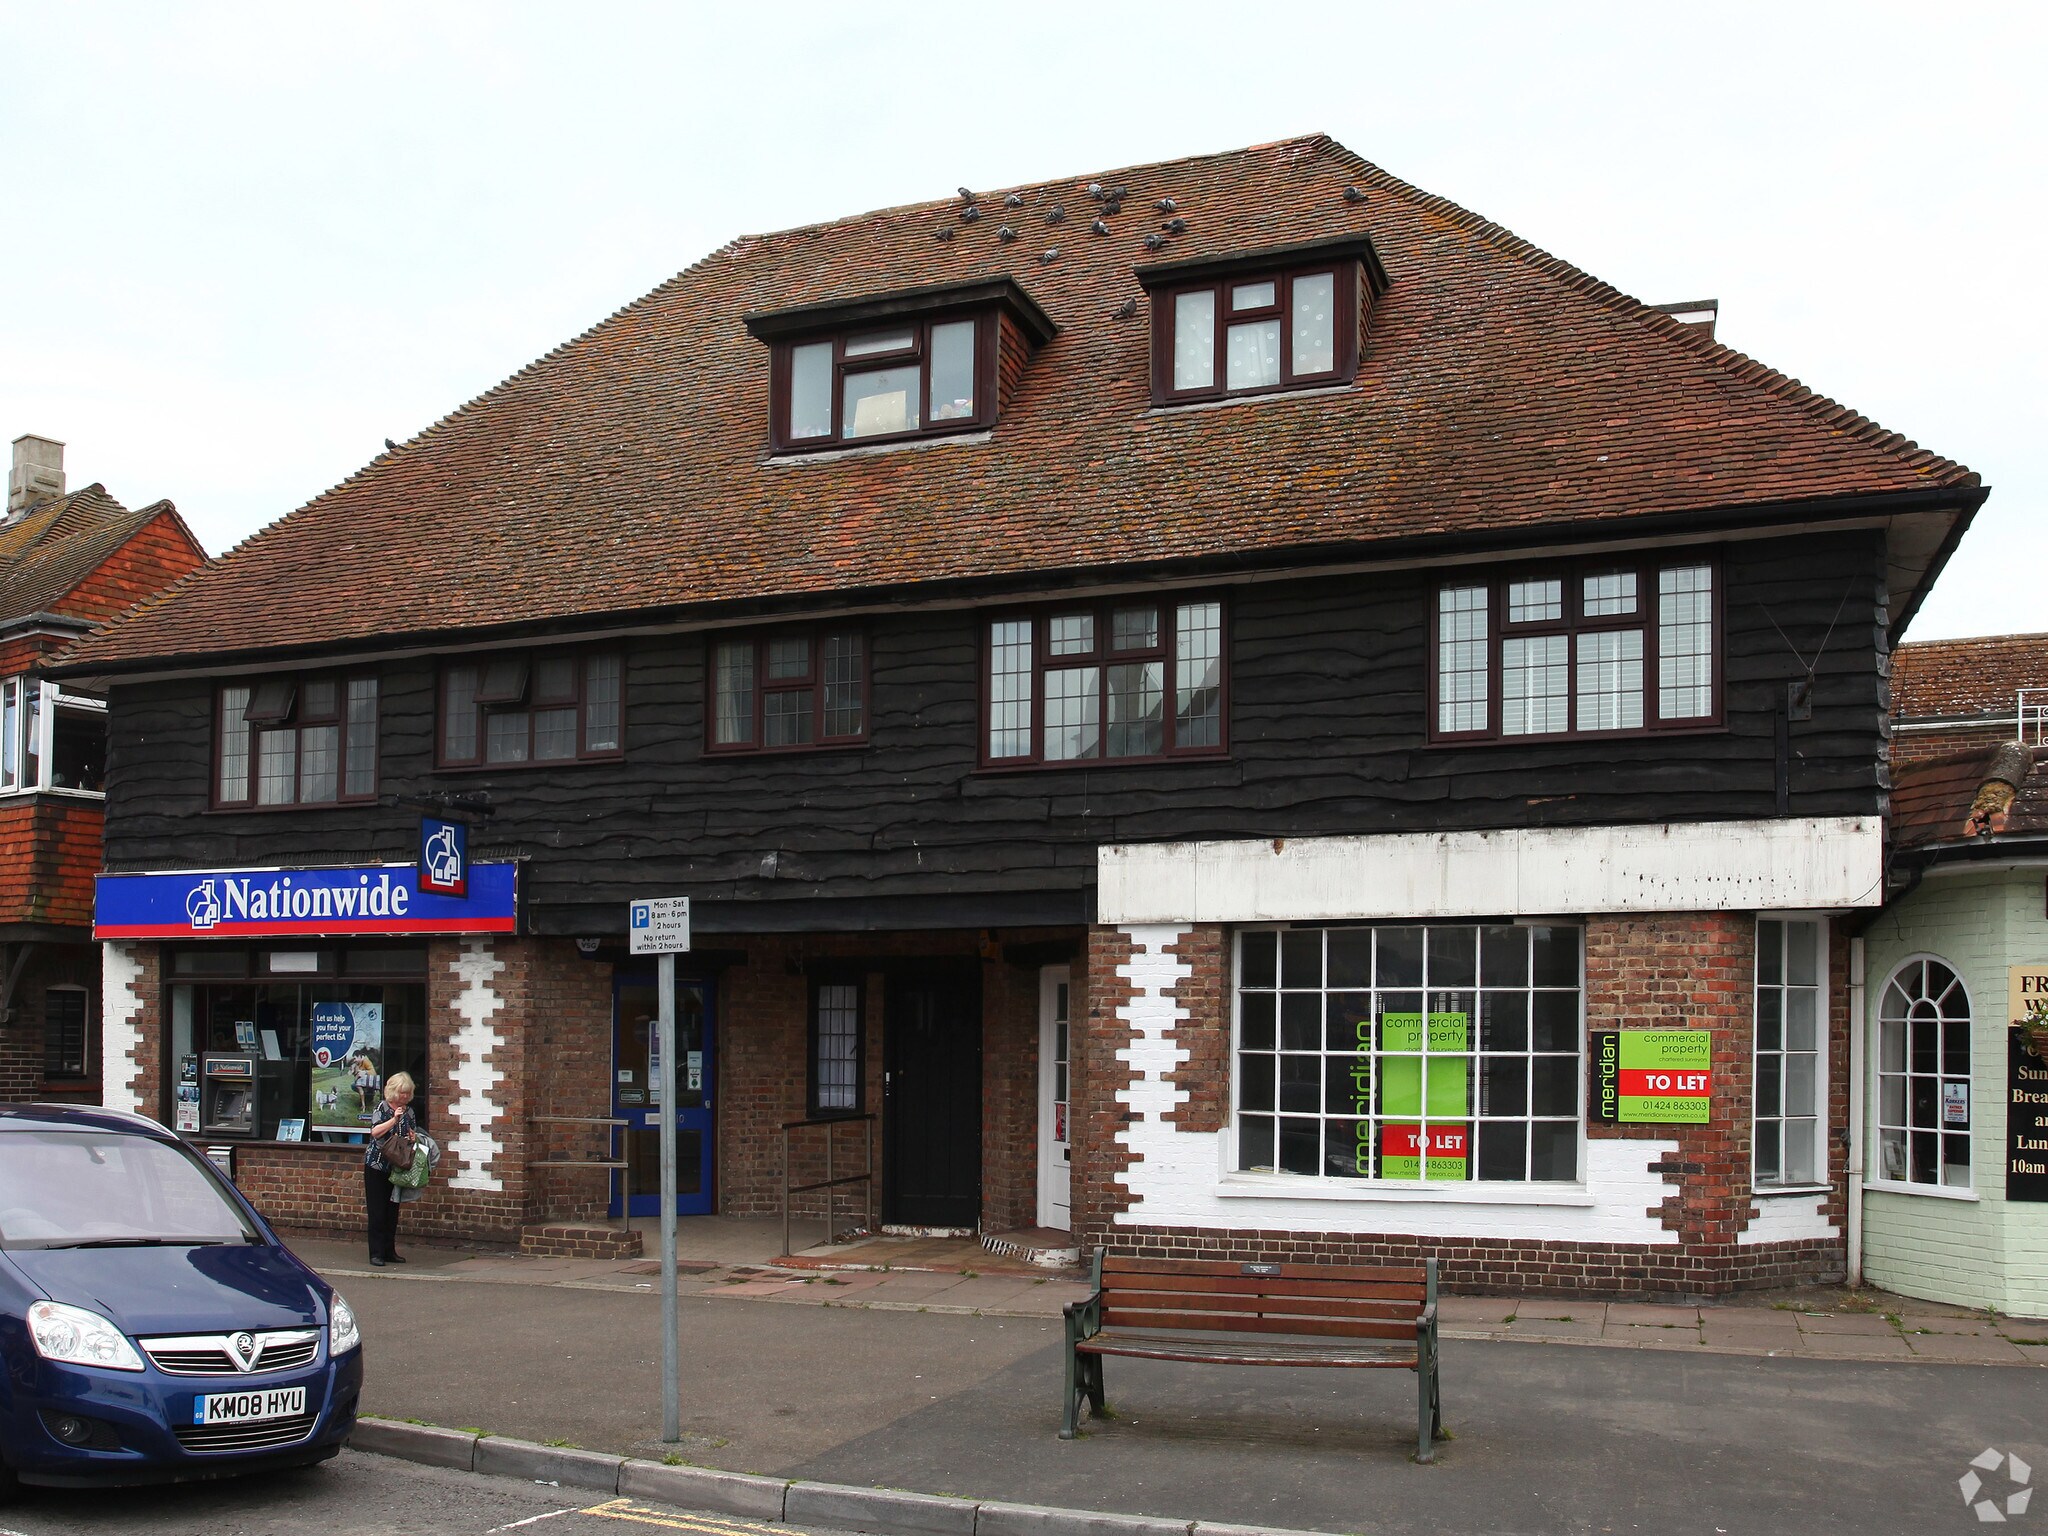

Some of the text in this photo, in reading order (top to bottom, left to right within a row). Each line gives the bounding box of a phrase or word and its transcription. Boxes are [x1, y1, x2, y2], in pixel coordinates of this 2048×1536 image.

[223, 874, 408, 919] Nationwide
[673, 900, 684, 908] Sat
[636, 908, 647, 926] P
[334, 1014, 346, 1023] help
[316, 1033, 336, 1041] perfect
[1407, 1030, 1463, 1043] prperty
[1644, 1034, 1708, 1042] commercial
[1662, 1044, 1707, 1054] property
[1599, 1035, 1616, 1118] meridian
[1646, 1075, 1707, 1090] TO LET
[1642, 1101, 1706, 1110] 01424 863303
[1408, 1134, 1462, 1148] TO LET
[1432, 1160, 1462, 1169] 863303
[2012, 1159, 2046, 1174] 10am
[210, 1390, 302, 1419] KM08 HYU
